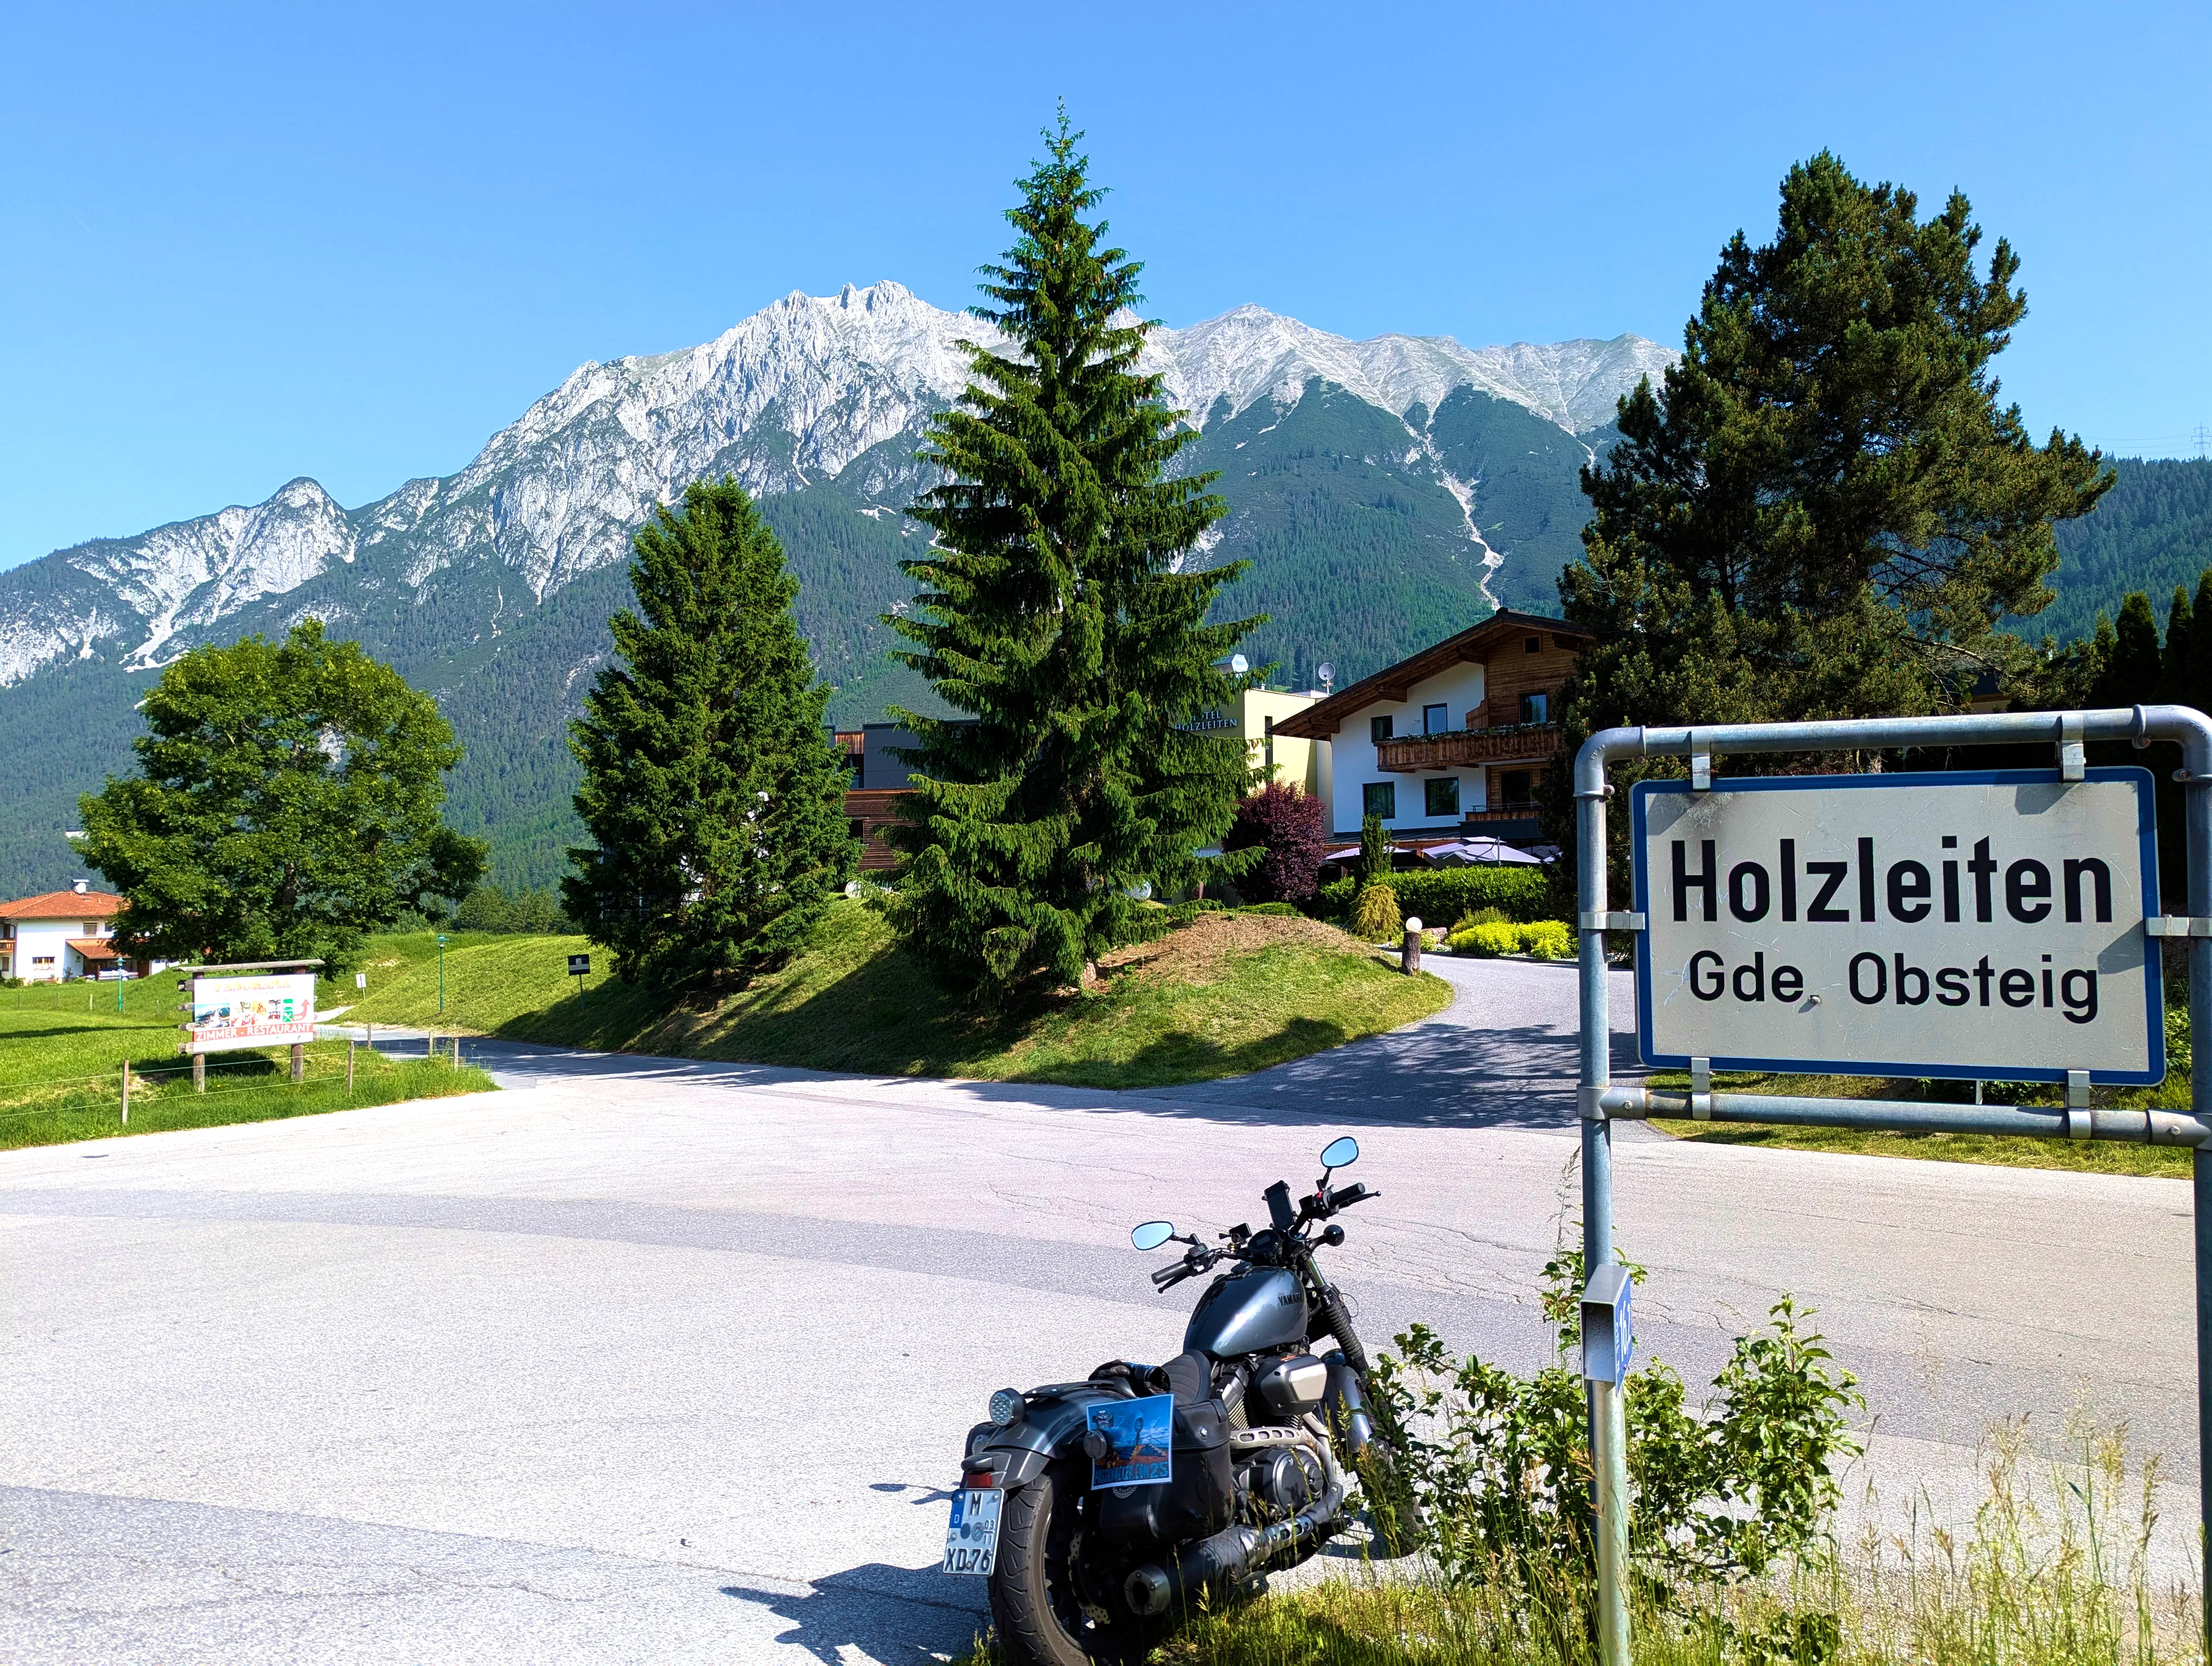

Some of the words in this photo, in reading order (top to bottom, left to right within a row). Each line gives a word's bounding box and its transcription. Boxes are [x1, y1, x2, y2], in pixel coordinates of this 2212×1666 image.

[1191, 710, 1221, 721] TEL
[1175, 719, 1237, 732] HOLZLEITEN
[1672, 836, 2112, 923] Holzleiten
[215, 979, 291, 992] PANORAMA
[1690, 950, 1804, 1002] Gde
[1849, 951, 2098, 1024] Obsteig
[196, 1028, 237, 1042] ZIMMER
[247, 1023, 311, 1036] RESTAURANT
[1149, 1461, 1168, 1478] 25
[969, 1492, 983, 1515] M
[954, 1514, 960, 1523] D
[984, 1520, 995, 1529] 03
[971, 1549, 991, 1572] 76
